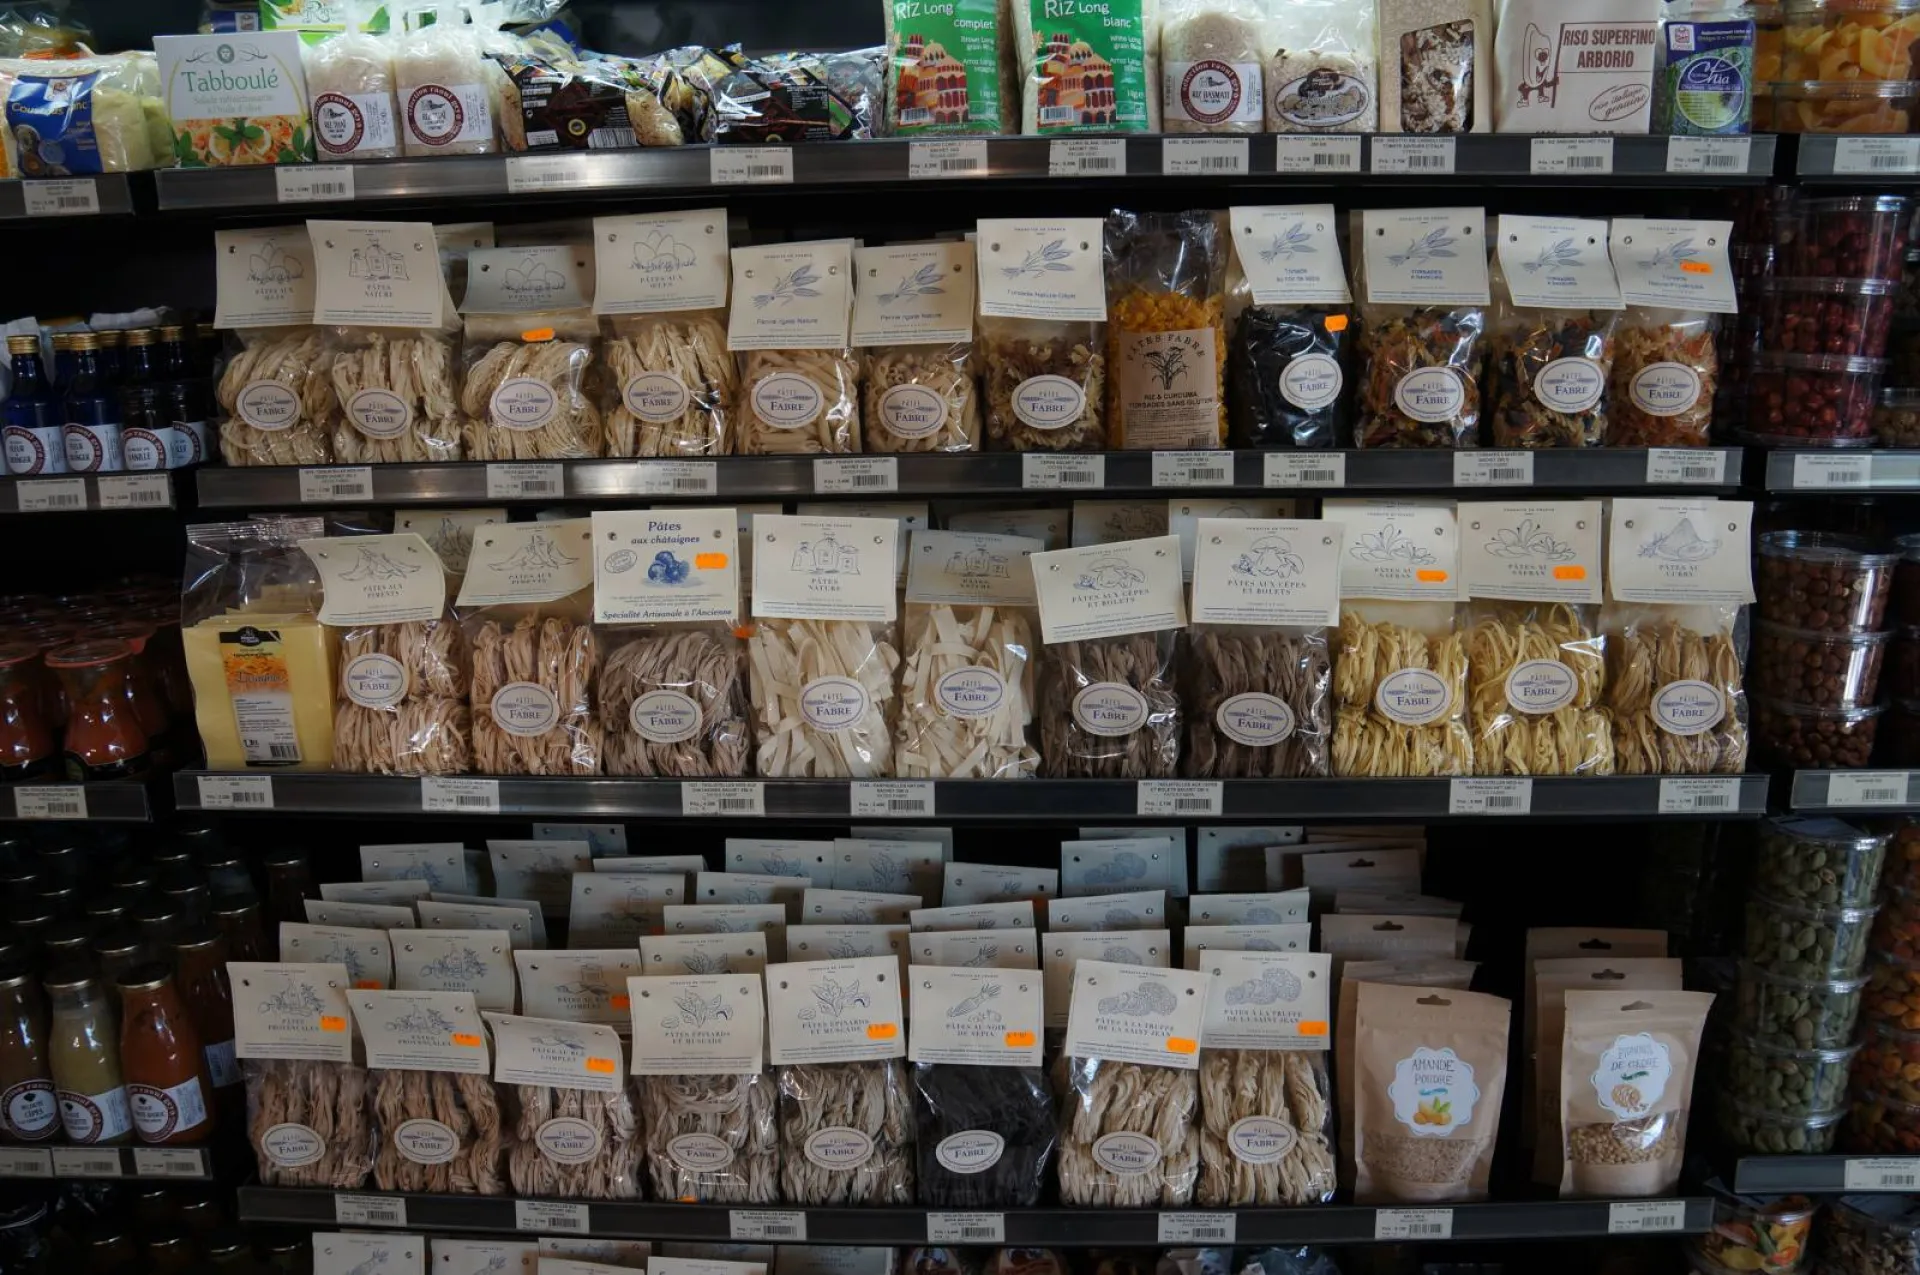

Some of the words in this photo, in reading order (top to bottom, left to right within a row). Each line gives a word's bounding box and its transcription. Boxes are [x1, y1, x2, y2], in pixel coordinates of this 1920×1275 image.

[894, 2, 920, 20] RIZ
[924, 2, 954, 16] Long
[1044, 0, 1075, 18] RIZ
[1079, 2, 1110, 14] Long
[954, 19, 994, 30] complet
[1104, 16, 1132, 28] blanc
[1563, 30, 1588, 46] RISO
[1592, 28, 1656, 46] SUPERFINO
[1577, 50, 1634, 68] ARBORIO
[180, 66, 280, 92] Tabboulé
[1299, 382, 1328, 392] FABRE
[1555, 386, 1588, 396] FABRE
[1416, 394, 1450, 404] FABRE
[1648, 390, 1682, 399] FABRE
[642, 398, 672, 407] FABRE
[771, 402, 804, 410] FABRE
[1032, 402, 1066, 412] FABRE
[509, 405, 540, 414] FABRE
[365, 414, 396, 423] FABRE
[896, 412, 928, 422] FABRE
[648, 521, 681, 532] Pâtes
[650, 534, 700, 546] châtaignes
[602, 610, 640, 619] Spécialité
[642, 609, 680, 618] Artisanale
[692, 608, 732, 617] l'Ancienne
[359, 682, 391, 690] FABRE
[1523, 687, 1556, 696] FABRE
[954, 692, 988, 702] FABRE
[1397, 696, 1430, 706] FABRE
[510, 710, 541, 720] FABRE
[816, 706, 852, 716] FABRE
[1093, 710, 1128, 720] FABRE
[1672, 708, 1704, 717] FABRE
[650, 716, 683, 726] FABRE
[1238, 718, 1272, 730] FABRE
[1412, 1059, 1455, 1072] AMANDE
[1414, 1074, 1453, 1086] POUDRE
[412, 1140, 442, 1150] FABRE
[1248, 1138, 1278, 1147] FABRE
[278, 1146, 310, 1154] FABRE
[954, 1149, 986, 1158] FABRE
[1112, 1153, 1144, 1163] FABRE
